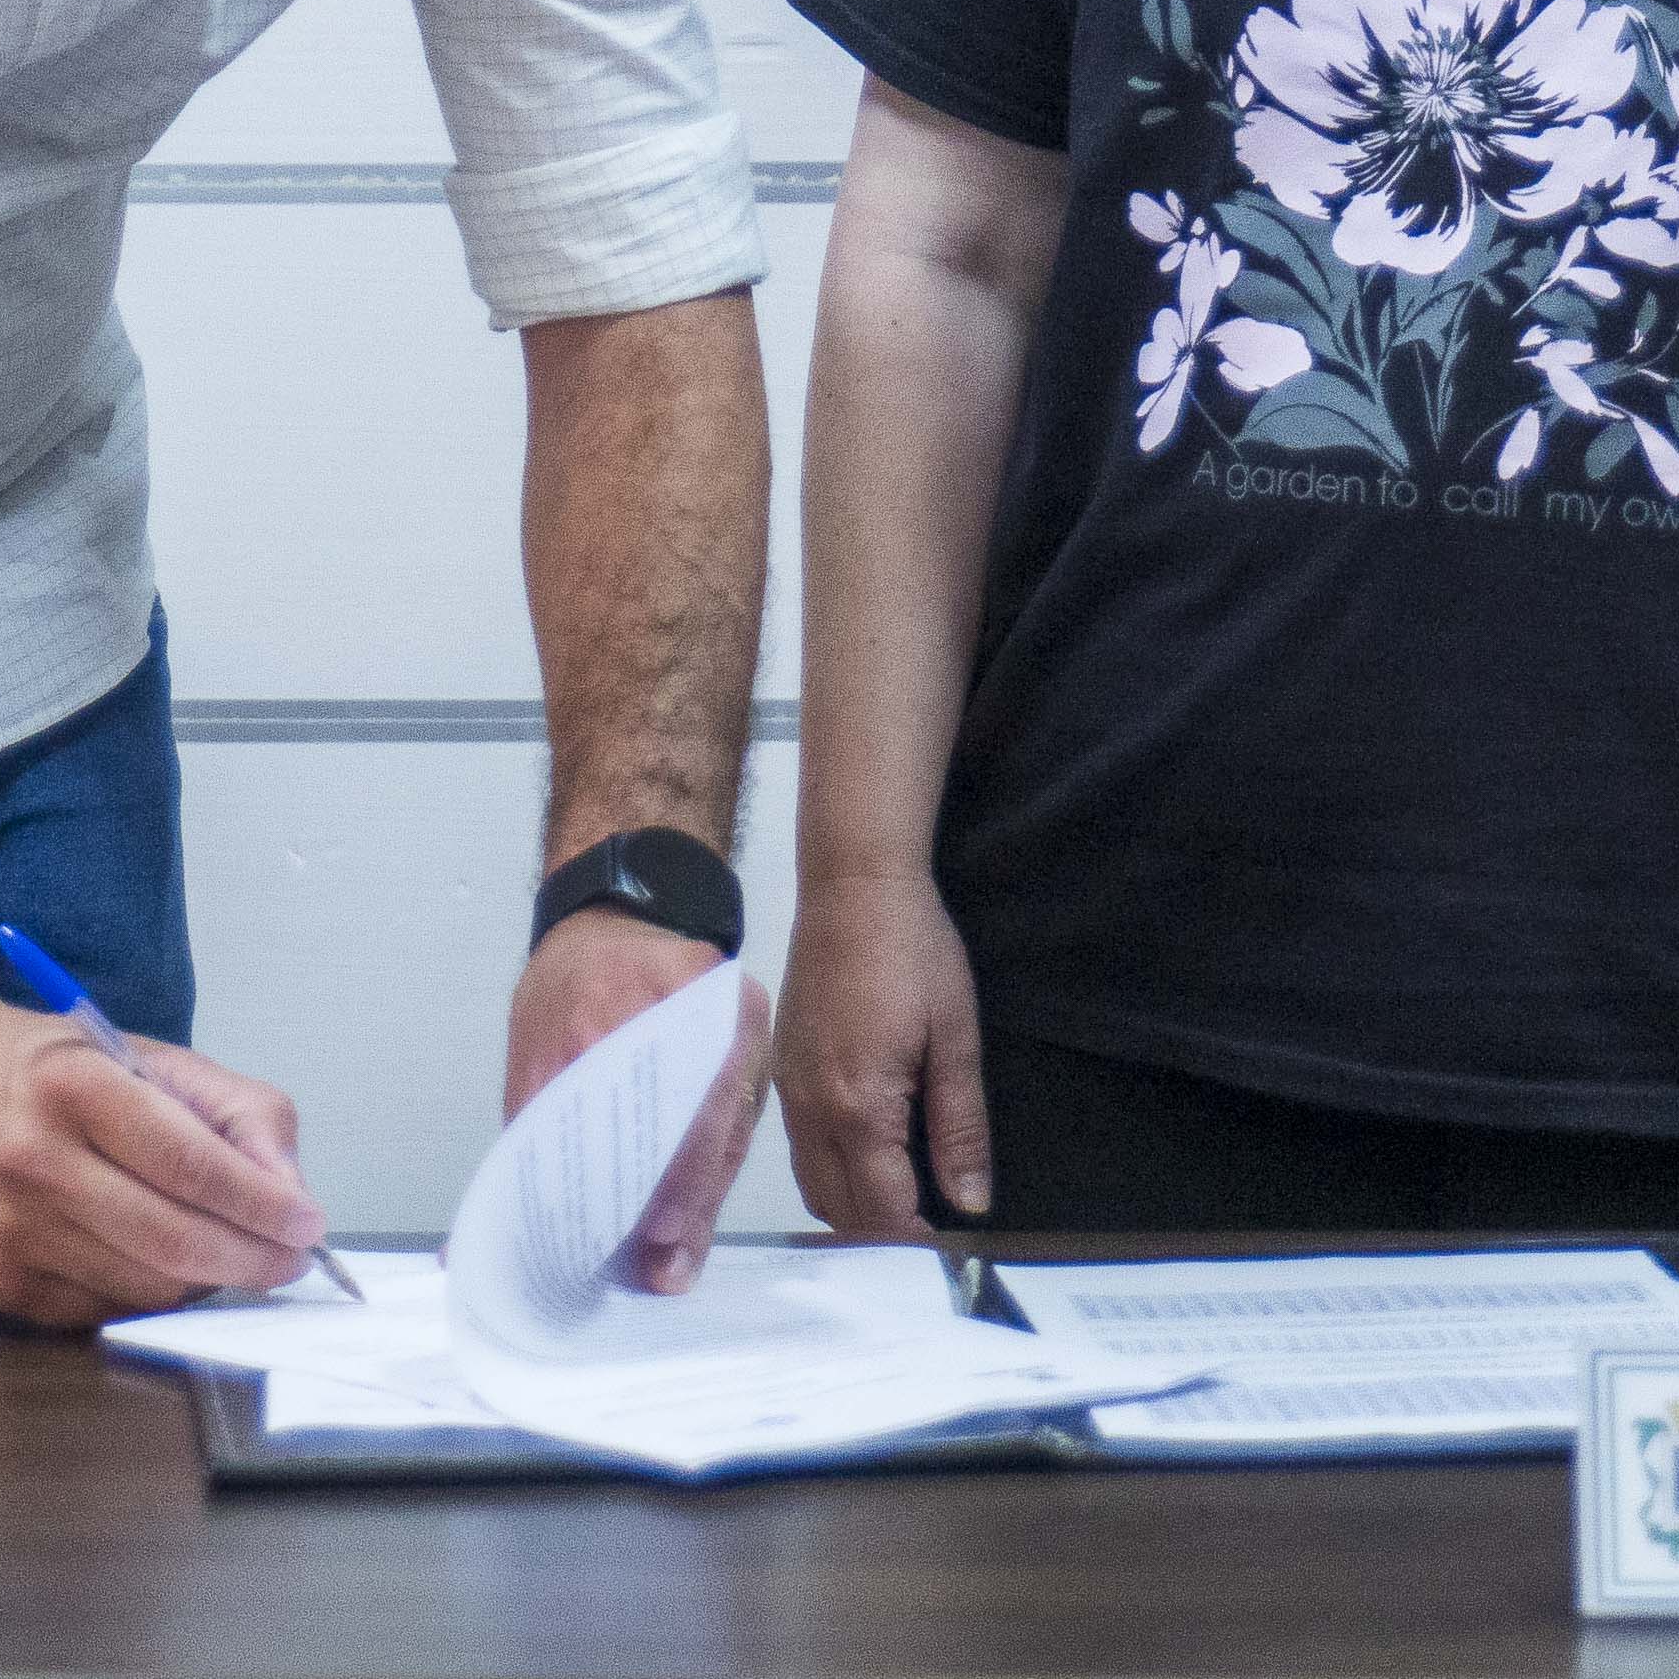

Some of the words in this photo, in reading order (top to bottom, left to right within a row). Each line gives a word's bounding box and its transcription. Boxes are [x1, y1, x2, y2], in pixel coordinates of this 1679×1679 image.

[1192, 451, 1219, 487] A
[1224, 457, 1367, 507] garden
[1376, 465, 1419, 508] to
[1442, 477, 1521, 520] call
[1545, 489, 1613, 532] my
